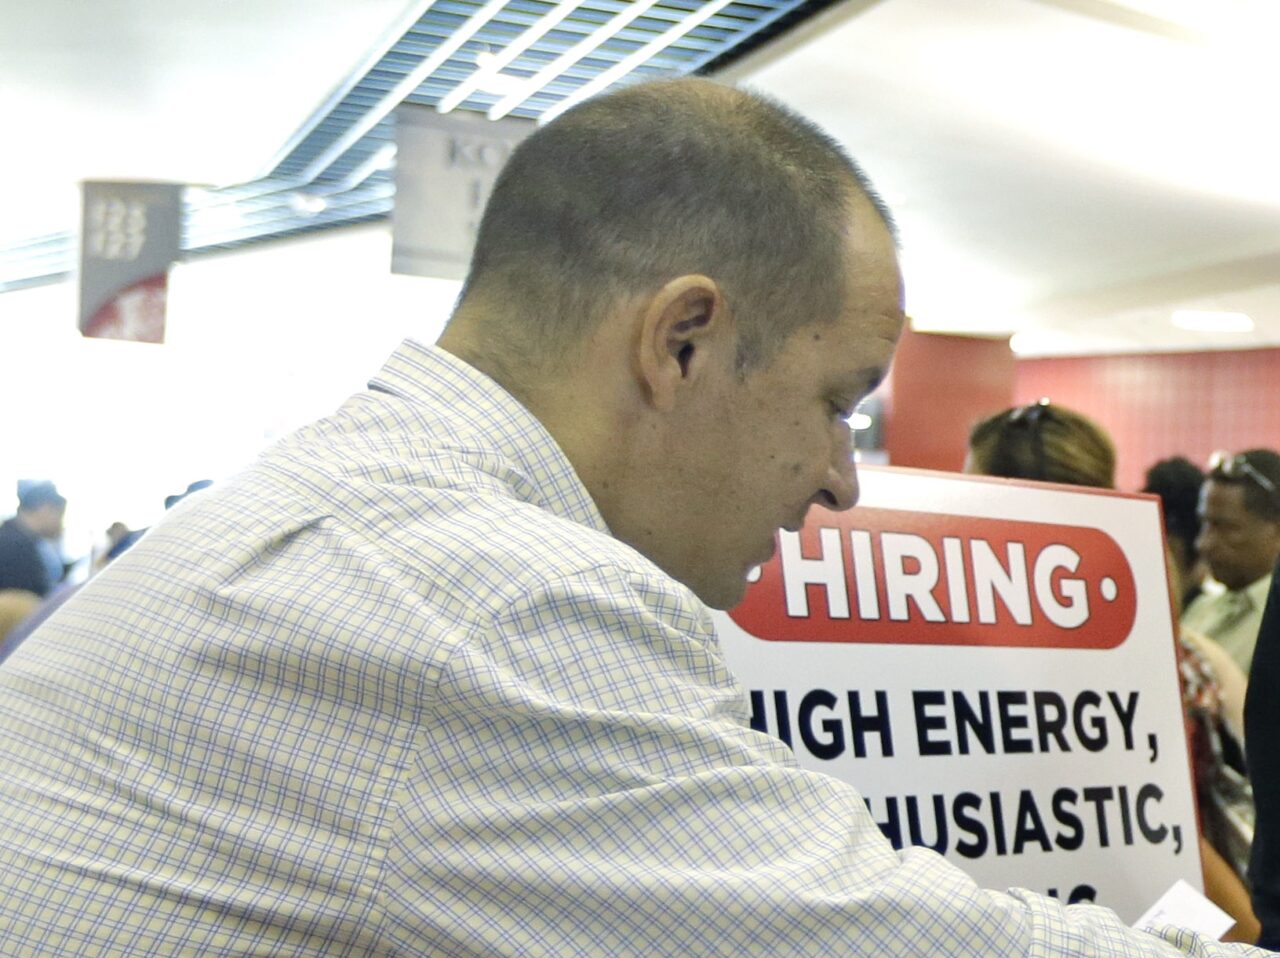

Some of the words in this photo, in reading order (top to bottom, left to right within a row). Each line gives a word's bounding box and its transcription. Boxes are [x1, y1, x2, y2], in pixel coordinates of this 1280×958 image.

[779, 527, 1091, 629] HIRING
[911, 690, 1159, 763] ENERGY,
[863, 783, 1183, 859] HUSIASTIC,
